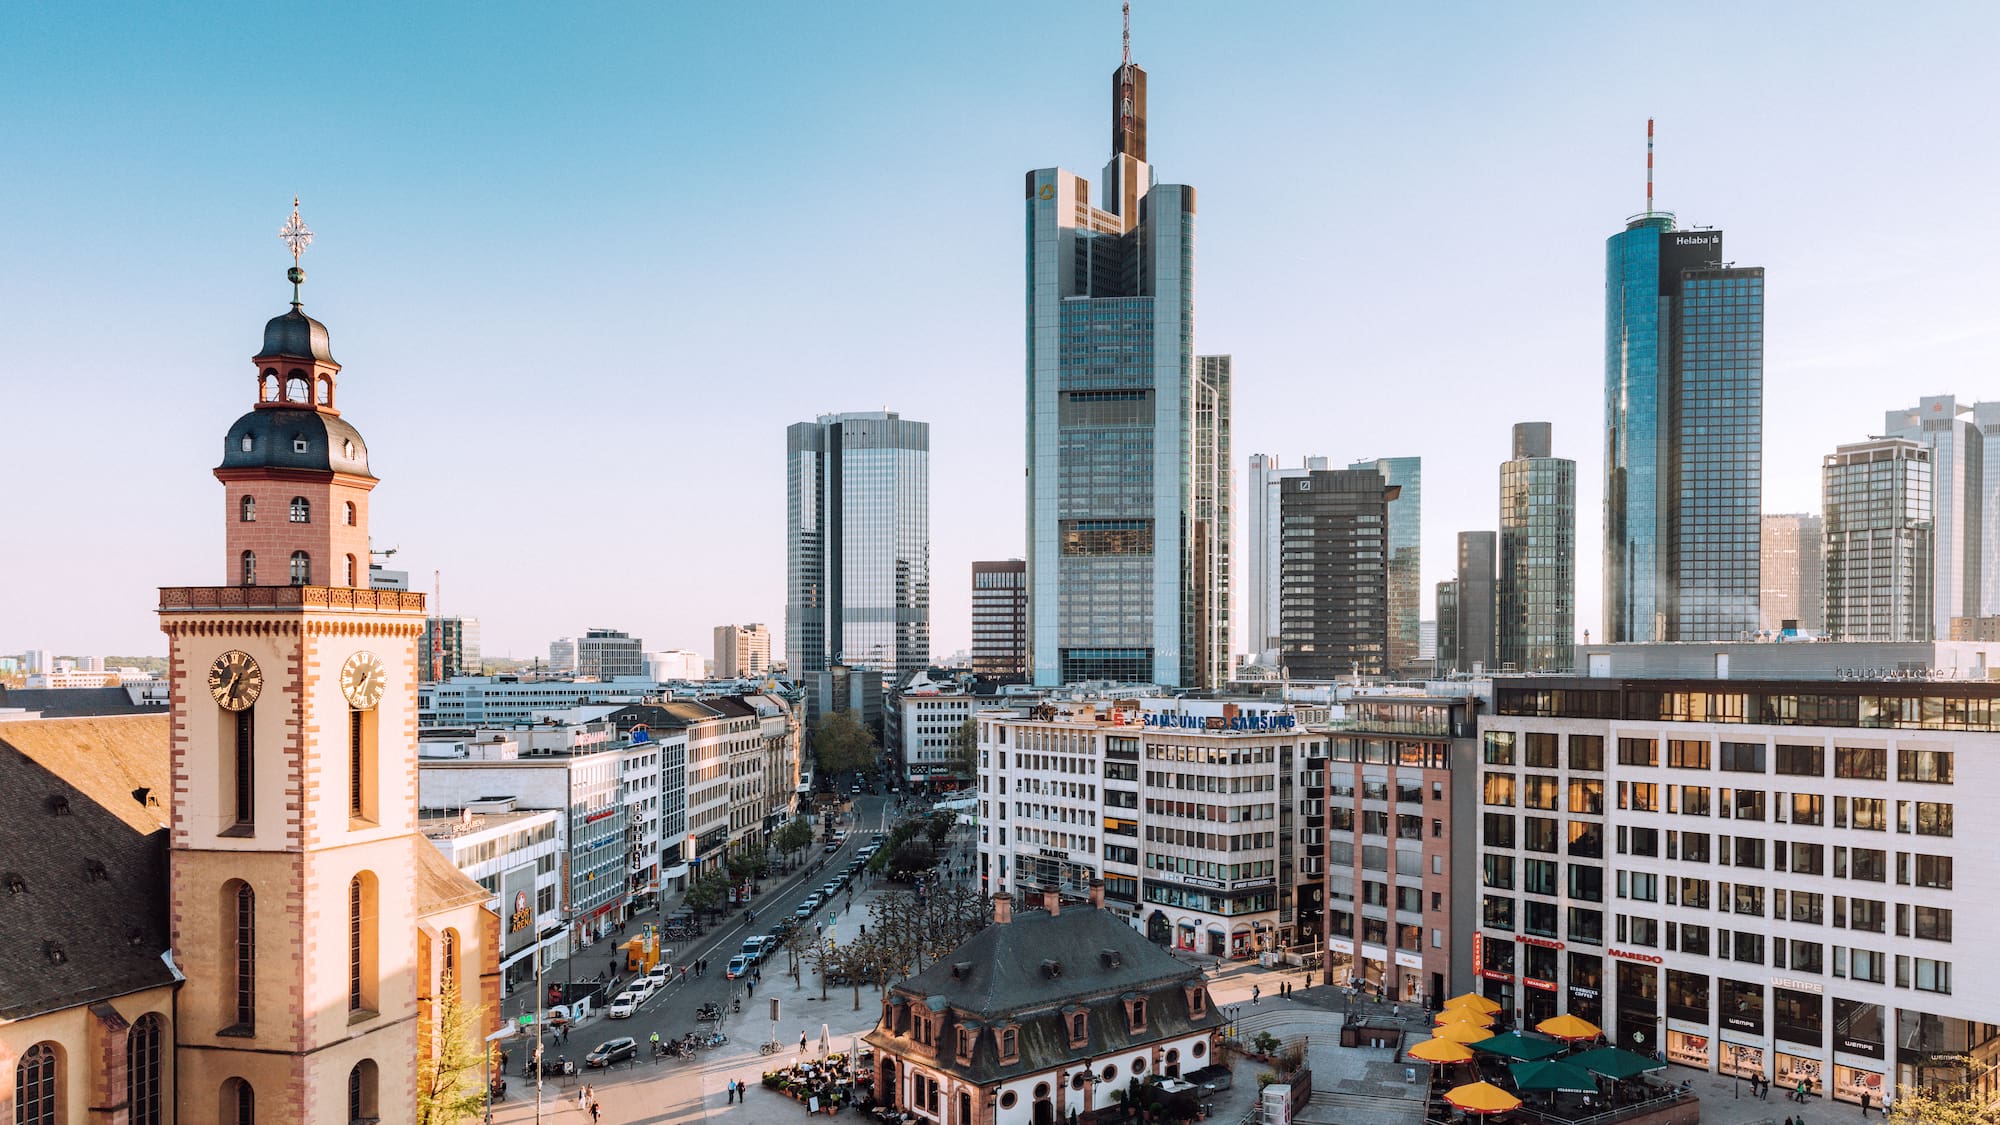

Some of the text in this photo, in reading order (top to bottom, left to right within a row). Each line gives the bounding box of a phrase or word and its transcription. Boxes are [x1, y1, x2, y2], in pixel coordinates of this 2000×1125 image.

[1676, 236, 1708, 245] Helaba
[1836, 665, 1944, 679] hauptwache
[1143, 713, 1206, 729] SAMSUNG
[1230, 715, 1296, 731] SAMSUNG
[634, 803, 642, 851] HOTEL
[1040, 848, 1069, 859] PRANGE
[513, 907, 533, 923] SPORT
[512, 917, 533, 933] ARENA
[1516, 935, 1565, 950] MAREDO
[1608, 949, 1663, 964] MAREDO
[1570, 986, 1598, 995] STARBUCKS
[1770, 976, 1823, 993] WEMPE
[1575, 991, 1593, 999] COFFEE
[1729, 1018, 1754, 1028] WEMPE
[1845, 1040, 1874, 1051] WEMPE
